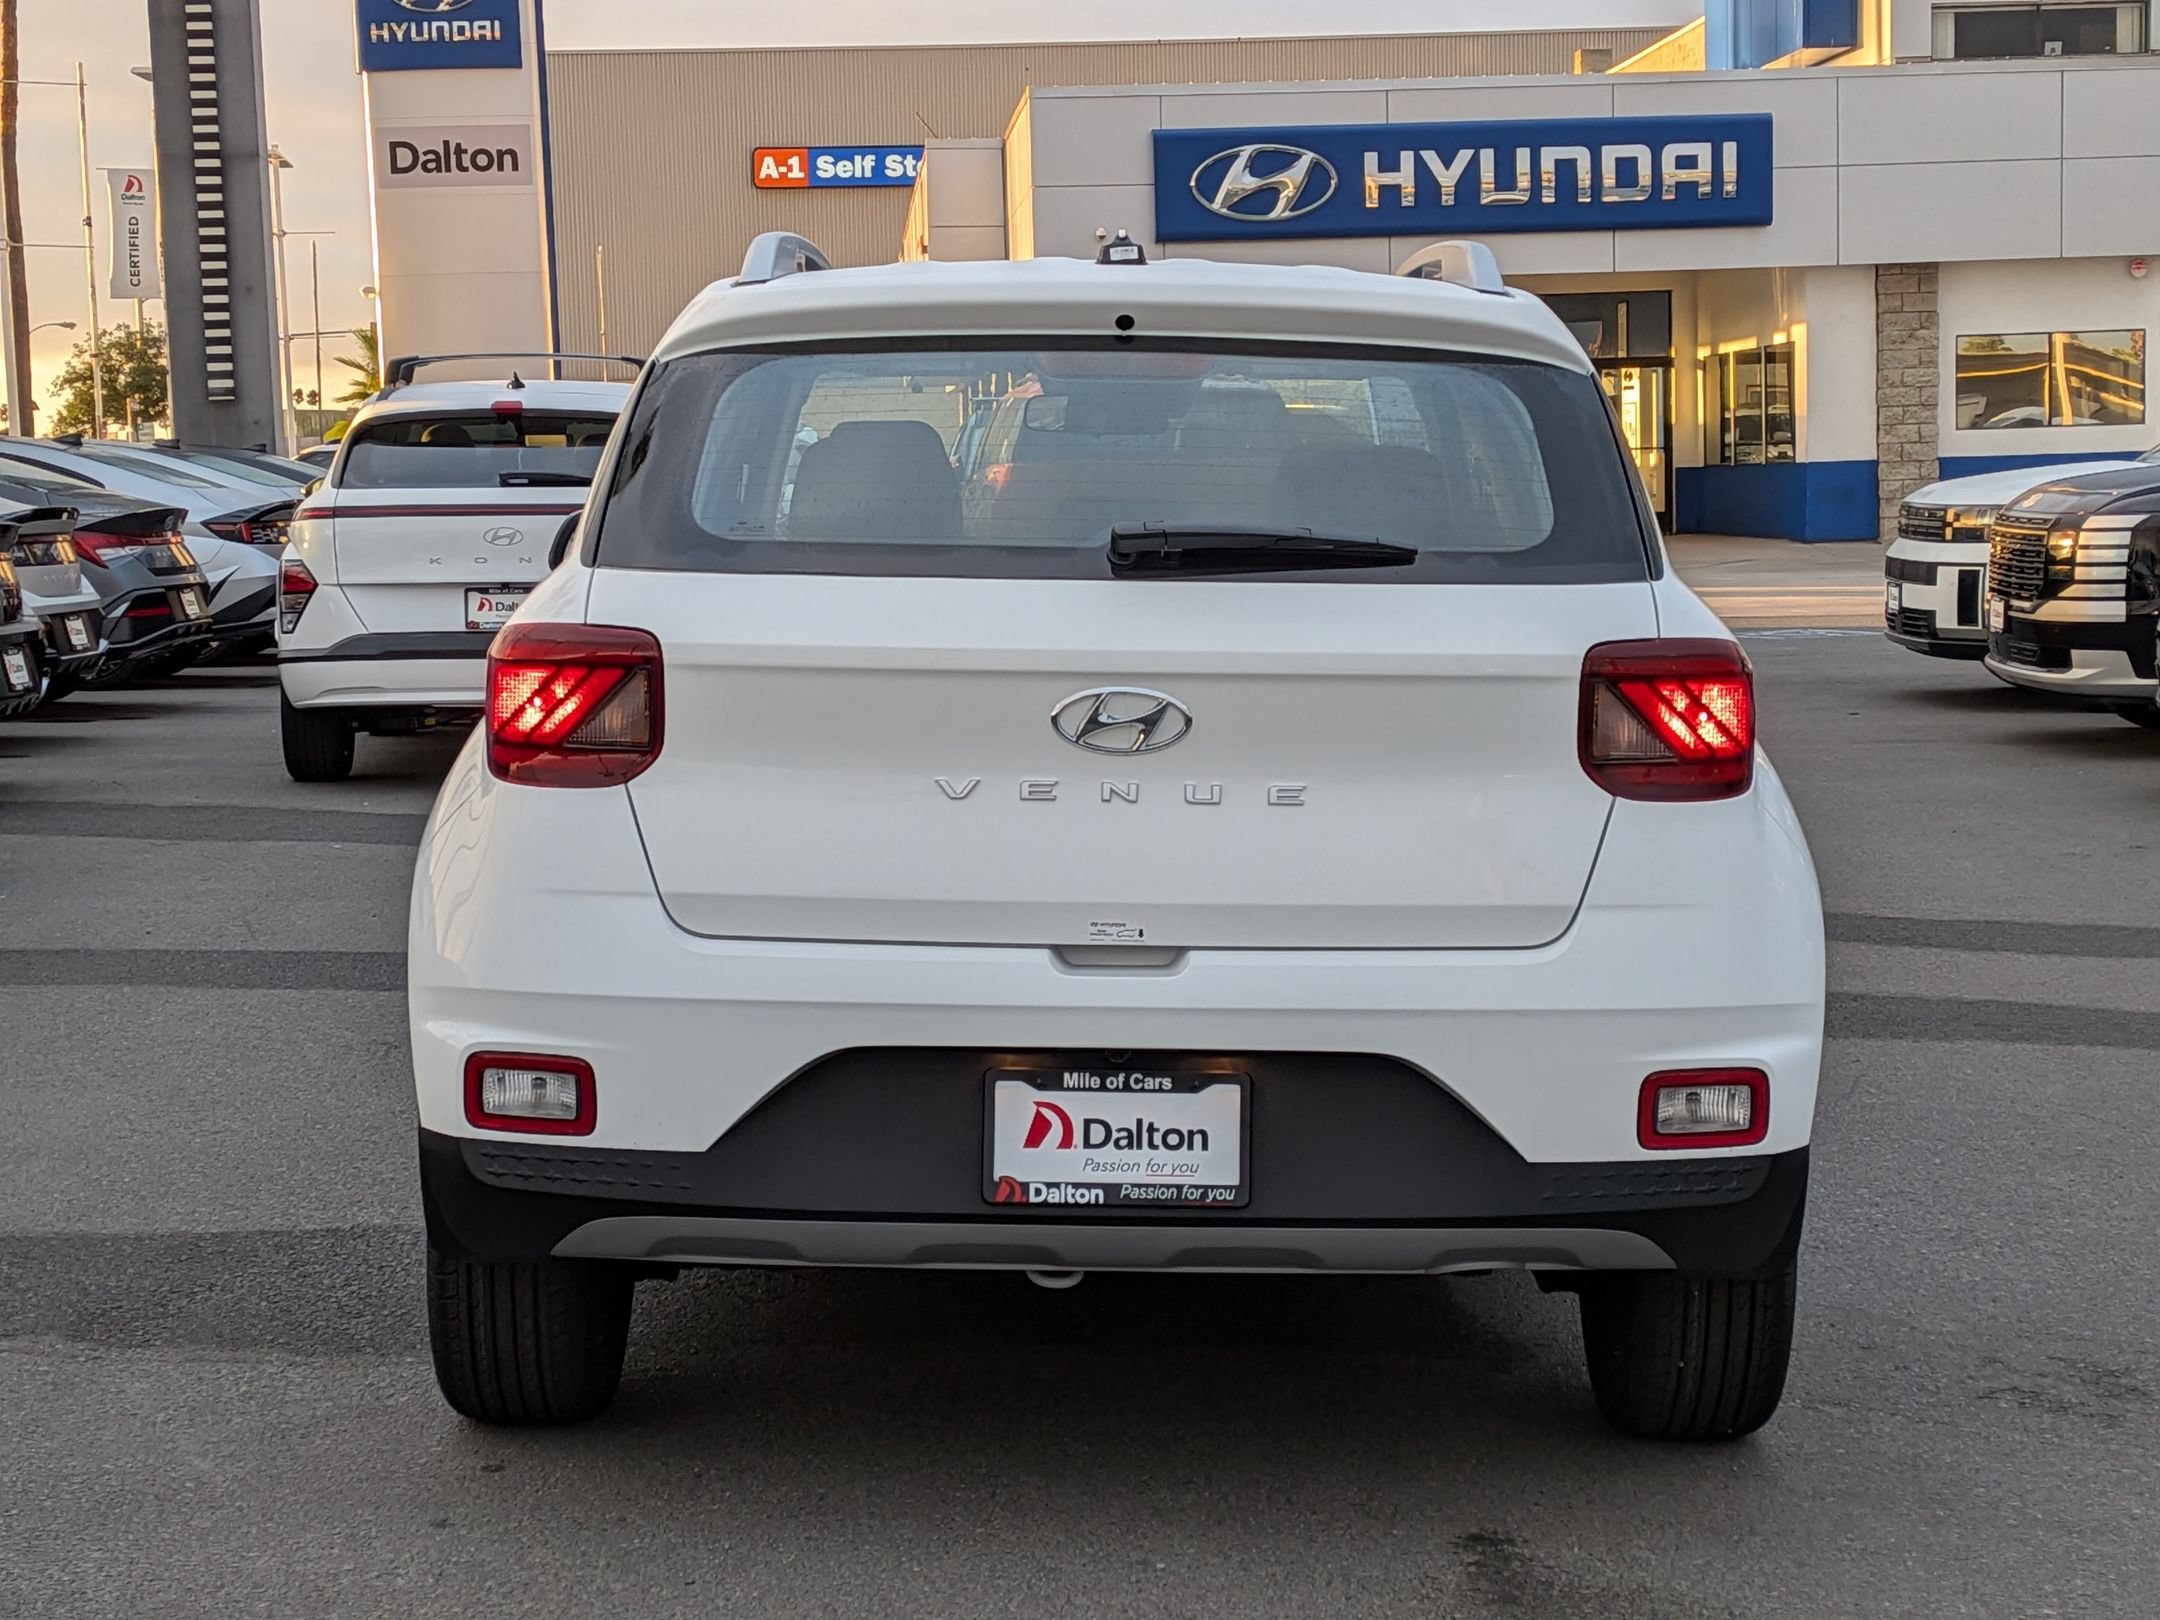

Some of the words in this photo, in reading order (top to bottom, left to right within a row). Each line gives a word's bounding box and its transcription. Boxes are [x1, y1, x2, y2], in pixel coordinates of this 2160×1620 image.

[370, 20, 502, 43] HYUNDAI
[389, 140, 519, 174] Dalton
[759, 156, 805, 179] A-1
[816, 155, 875, 178] Self
[1363, 141, 1737, 207] HYUNDAI
[128, 216, 141, 287] CERTIFIED
[935, 779, 1306, 806] VENUE
[1063, 1072, 1100, 1089] Mile
[1106, 1073, 1126, 1089] of
[1129, 1073, 1173, 1090] Cars
[1082, 1117, 1209, 1151] Dalton
[1082, 1158, 1140, 1173] Passion
[1145, 1158, 1168, 1174] for
[1171, 1162, 1200, 1176] you
[1028, 1182, 1104, 1205] Dalton
[1119, 1184, 1177, 1200] Passion
[1181, 1186, 1204, 1201] for
[1206, 1189, 1236, 1203] you
